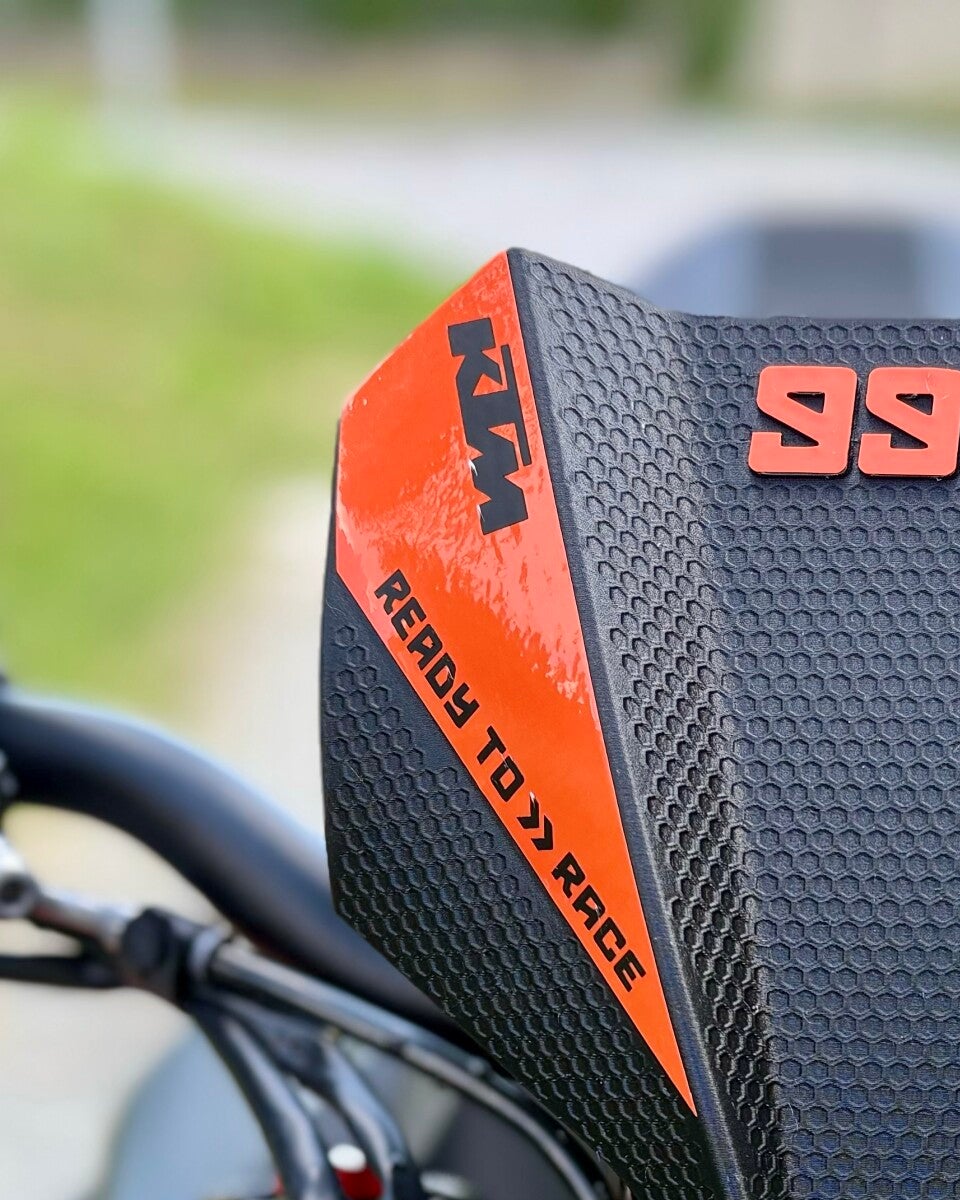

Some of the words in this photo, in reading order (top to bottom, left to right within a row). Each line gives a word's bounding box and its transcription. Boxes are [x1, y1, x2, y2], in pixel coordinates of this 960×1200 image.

[448, 317, 532, 535] KTM
[374, 569, 480, 729] READY
[476, 726, 525, 803] TO
[551, 852, 647, 993] RACE
